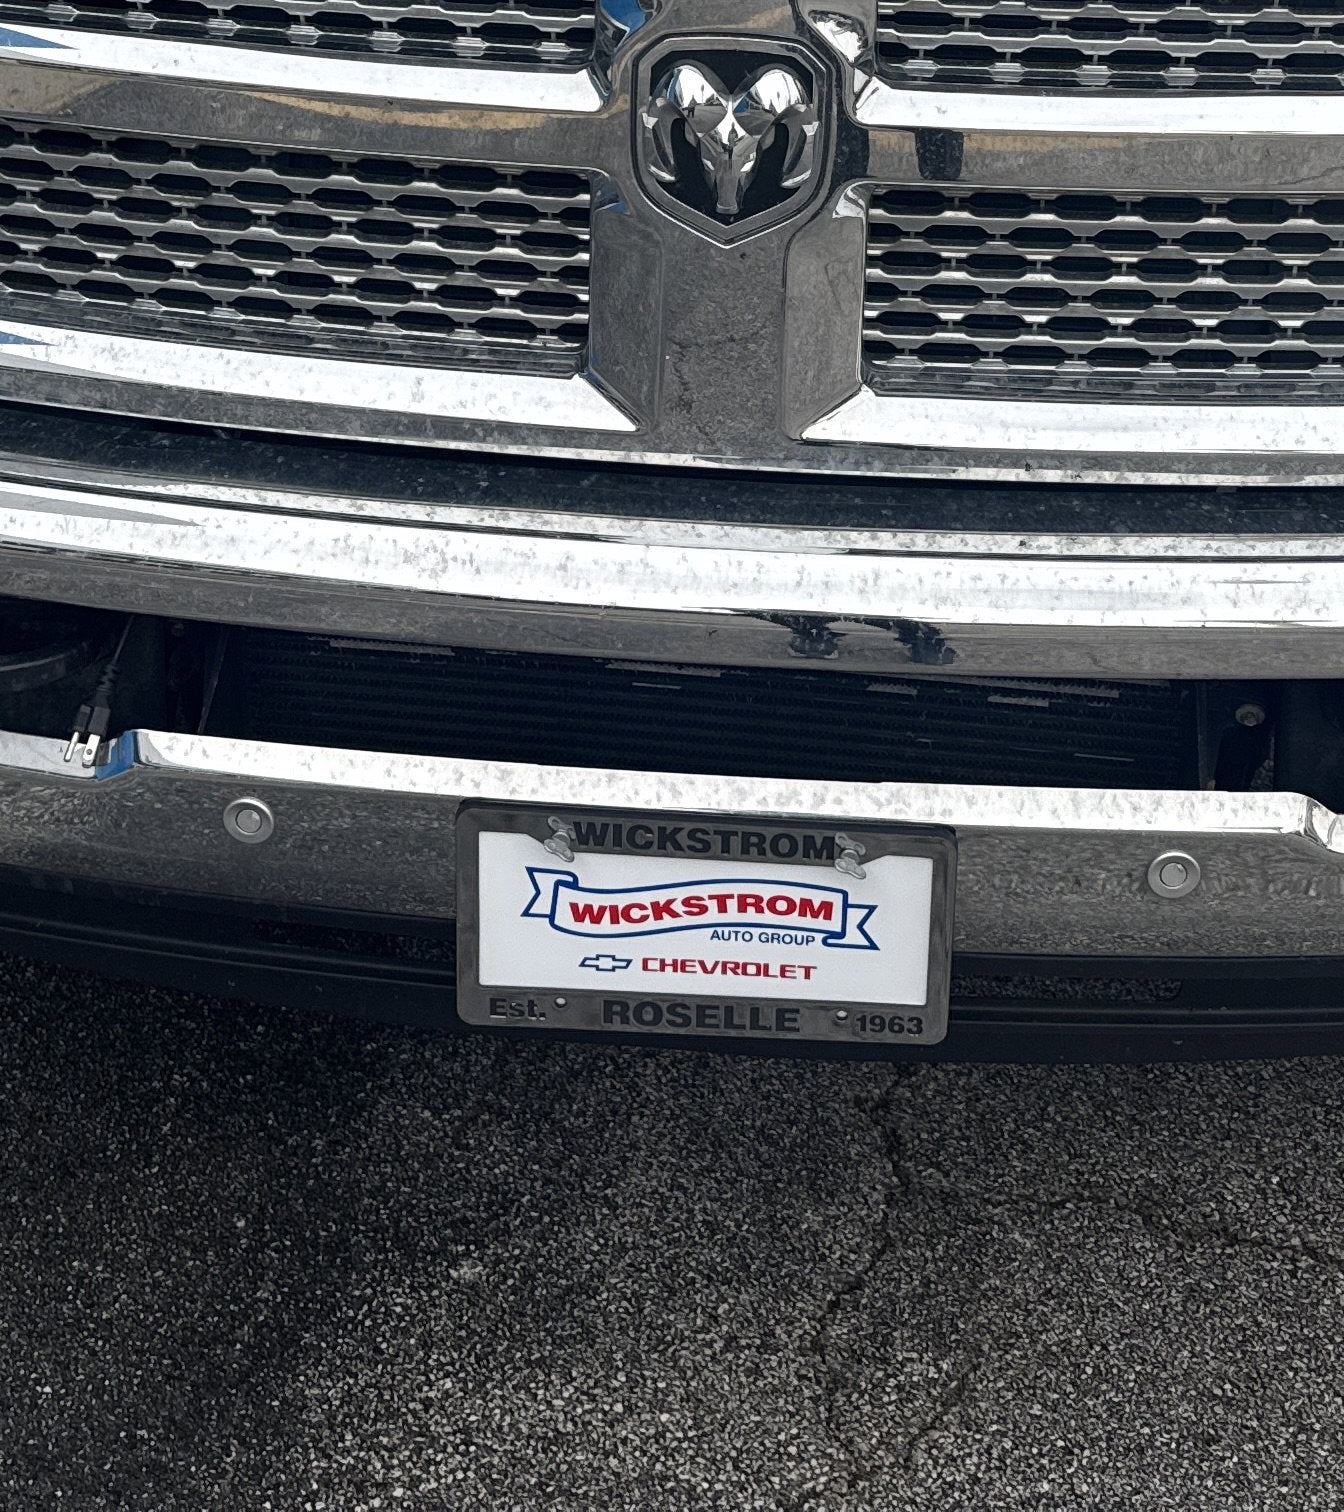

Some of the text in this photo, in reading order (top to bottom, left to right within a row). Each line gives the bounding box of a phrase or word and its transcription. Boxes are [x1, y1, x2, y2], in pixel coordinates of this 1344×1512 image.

[572, 820, 836, 862] WICKSTROM
[569, 893, 835, 926] WICKSTROM
[710, 929, 816, 947] AUTO GROUP
[641, 956, 818, 981] CHEVROLET
[489, 997, 924, 1037] Est. ROSELLE 1963
